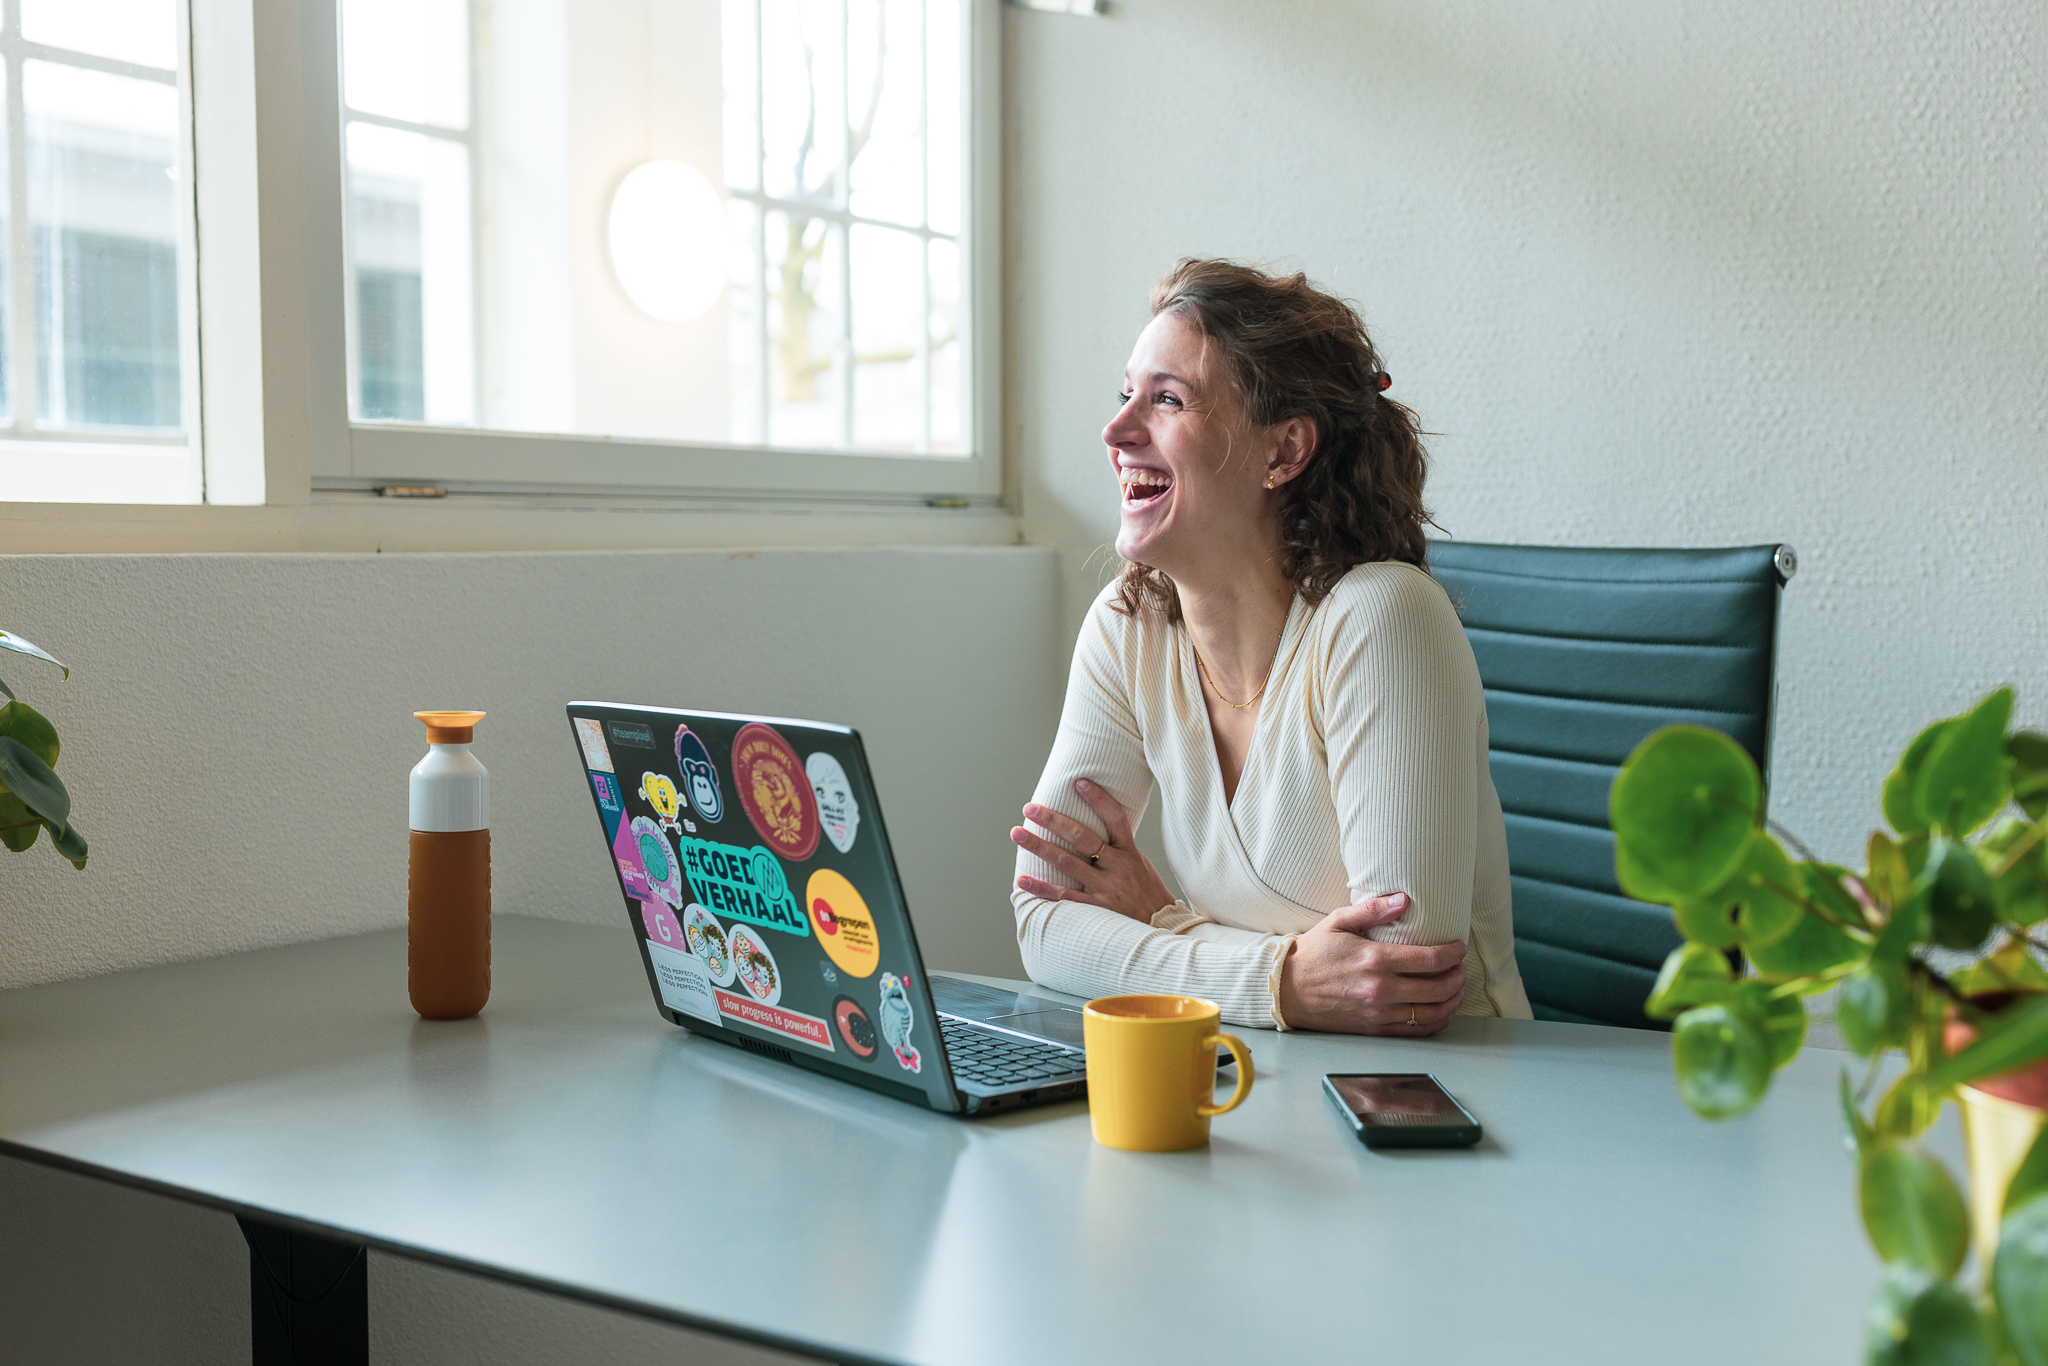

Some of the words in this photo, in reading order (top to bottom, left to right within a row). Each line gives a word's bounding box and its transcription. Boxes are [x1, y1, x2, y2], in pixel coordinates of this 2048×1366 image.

[692, 877, 803, 929] VERHAAL
[655, 914, 672, 942] G
[658, 962, 672, 973] LESS
[672, 968, 704, 983] PERFECTION
[660, 969, 674, 981] LESS
[674, 975, 706, 990] PERFECTION
[661, 977, 676, 988] LESS
[676, 982, 708, 997] PERFECTION
[723, 998, 739, 1011] slow
[741, 1005, 773, 1022] progress
[774, 1012, 782, 1025] is
[784, 1018, 822, 1038] powerful.
